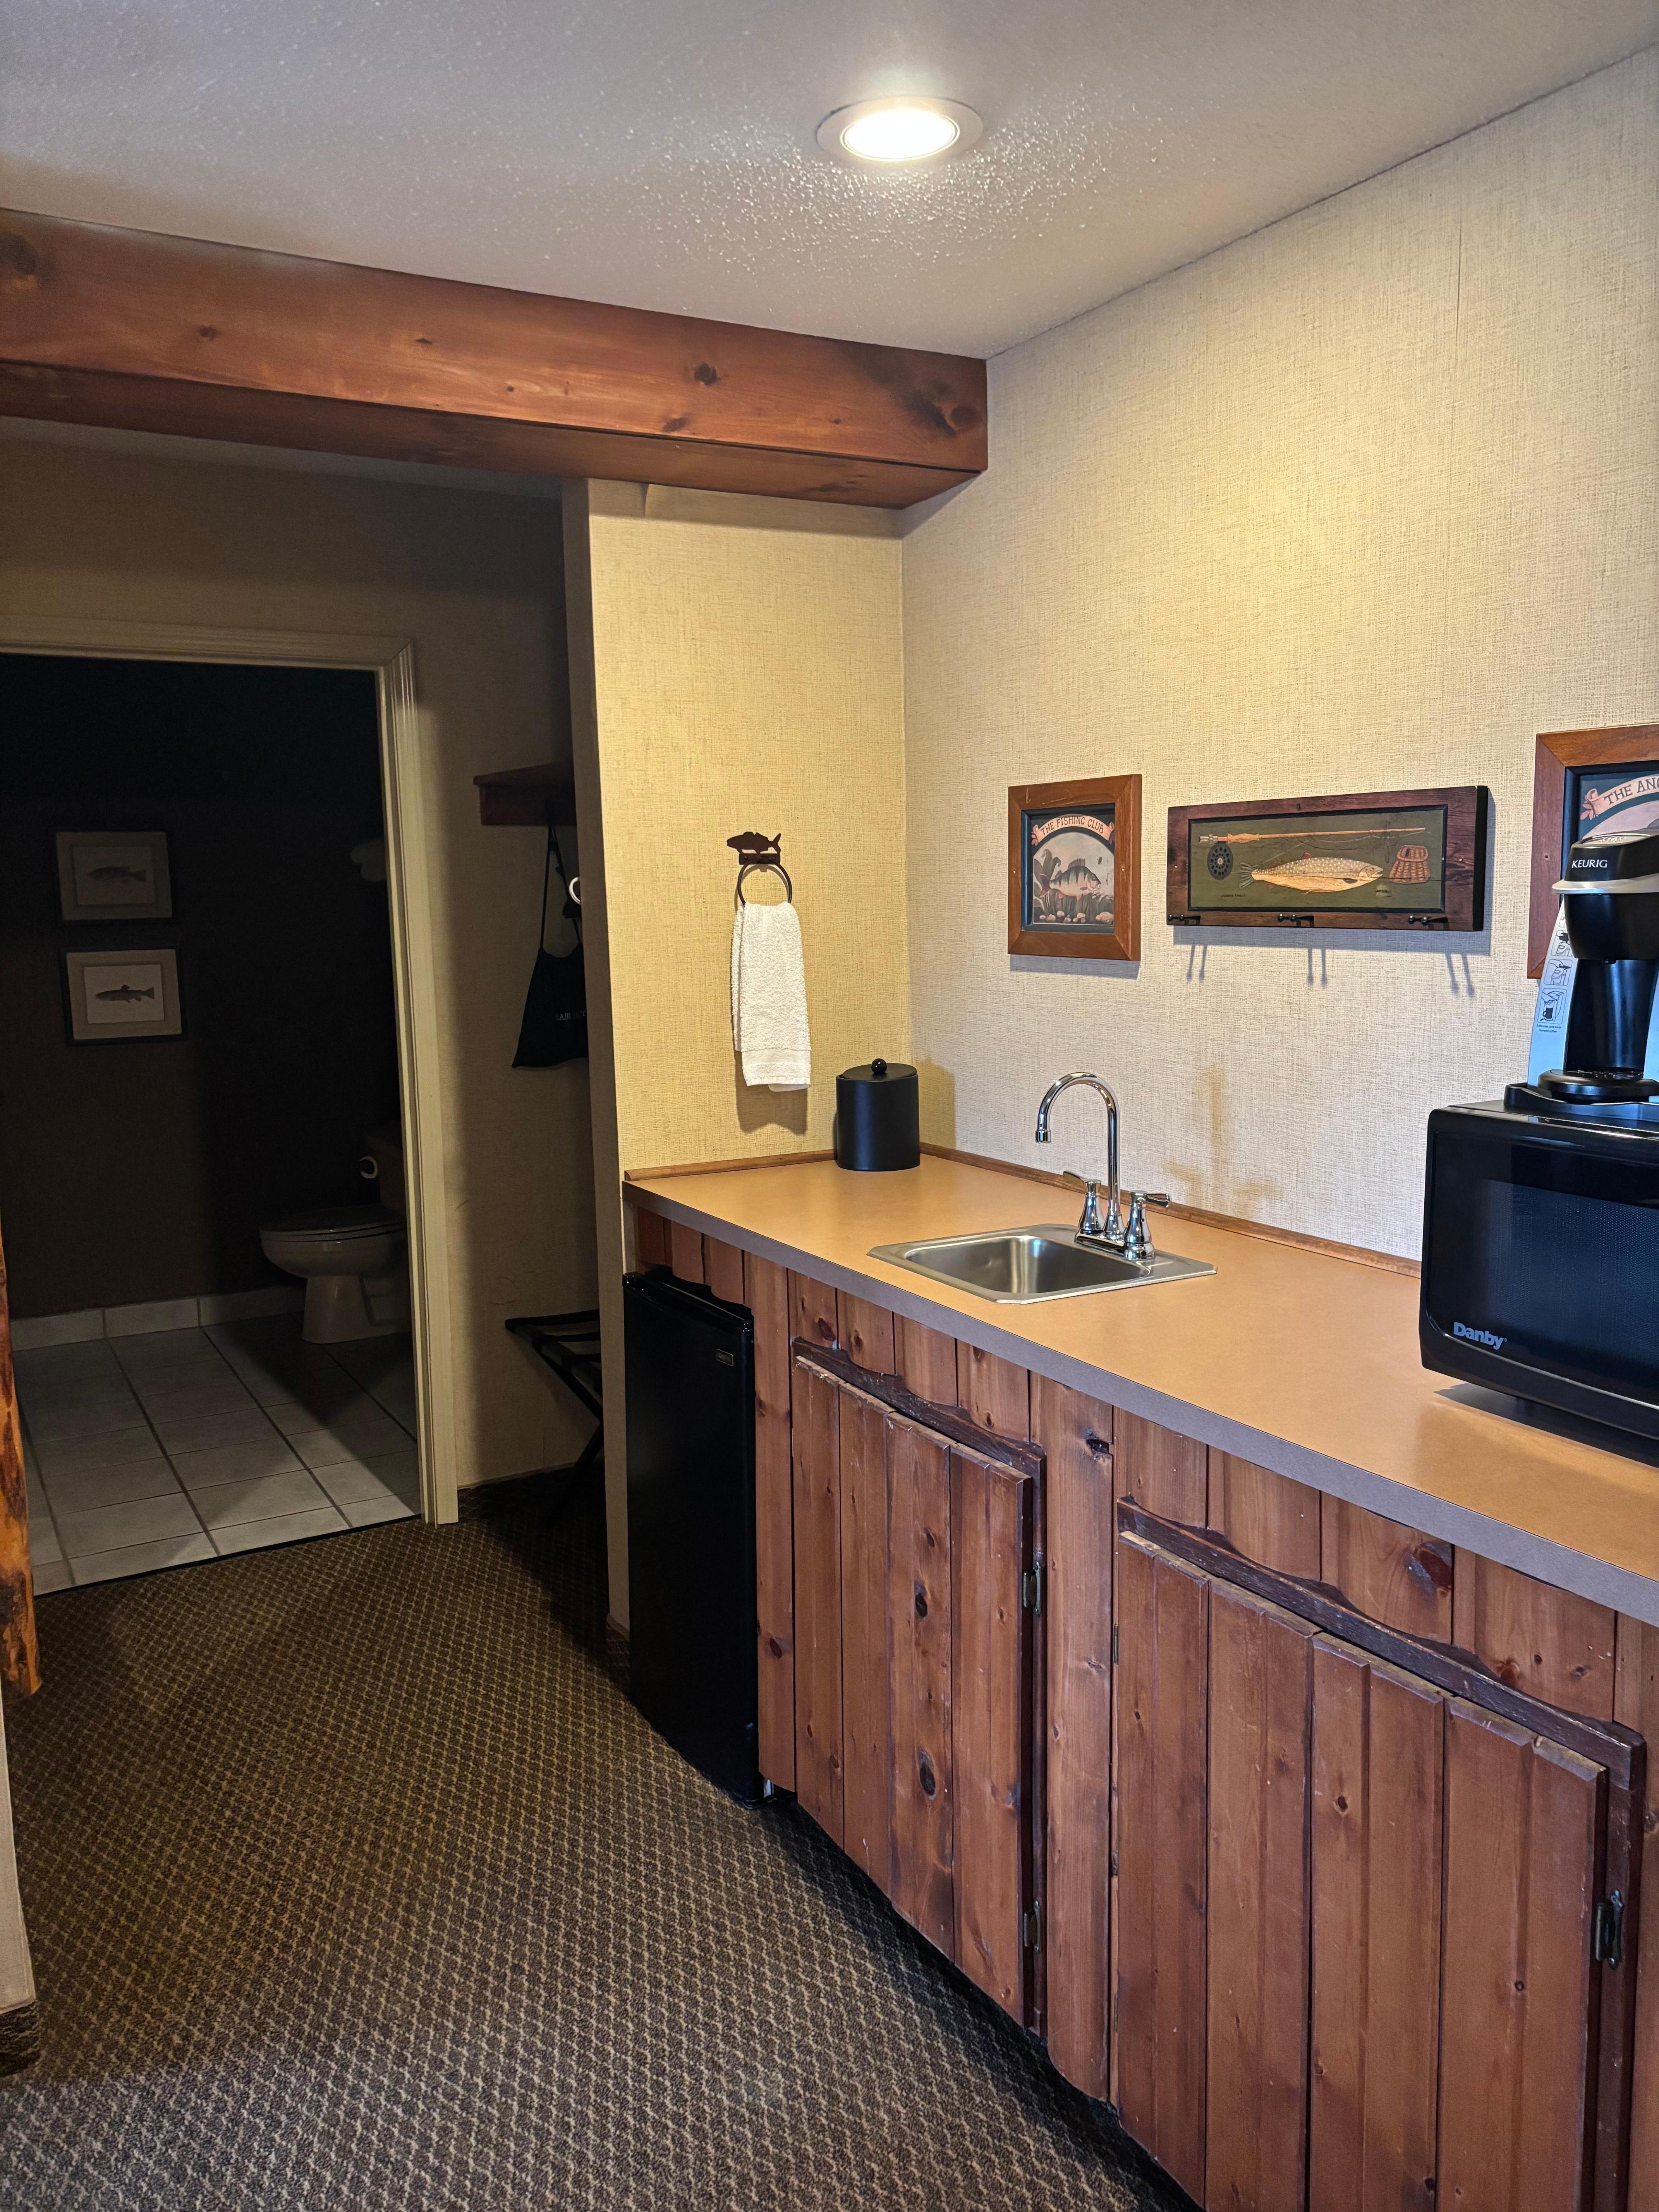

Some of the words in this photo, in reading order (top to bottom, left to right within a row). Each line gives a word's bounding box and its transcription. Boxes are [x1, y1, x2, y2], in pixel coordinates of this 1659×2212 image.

[1603, 783, 1633, 805] THE
[1041, 822, 1054, 835] THE
[1056, 816, 1085, 828] FISHING
[1087, 819, 1104, 834] CLUB
[1571, 859, 1607, 868] KEURIG
[1453, 1321, 1504, 1350] Danby
